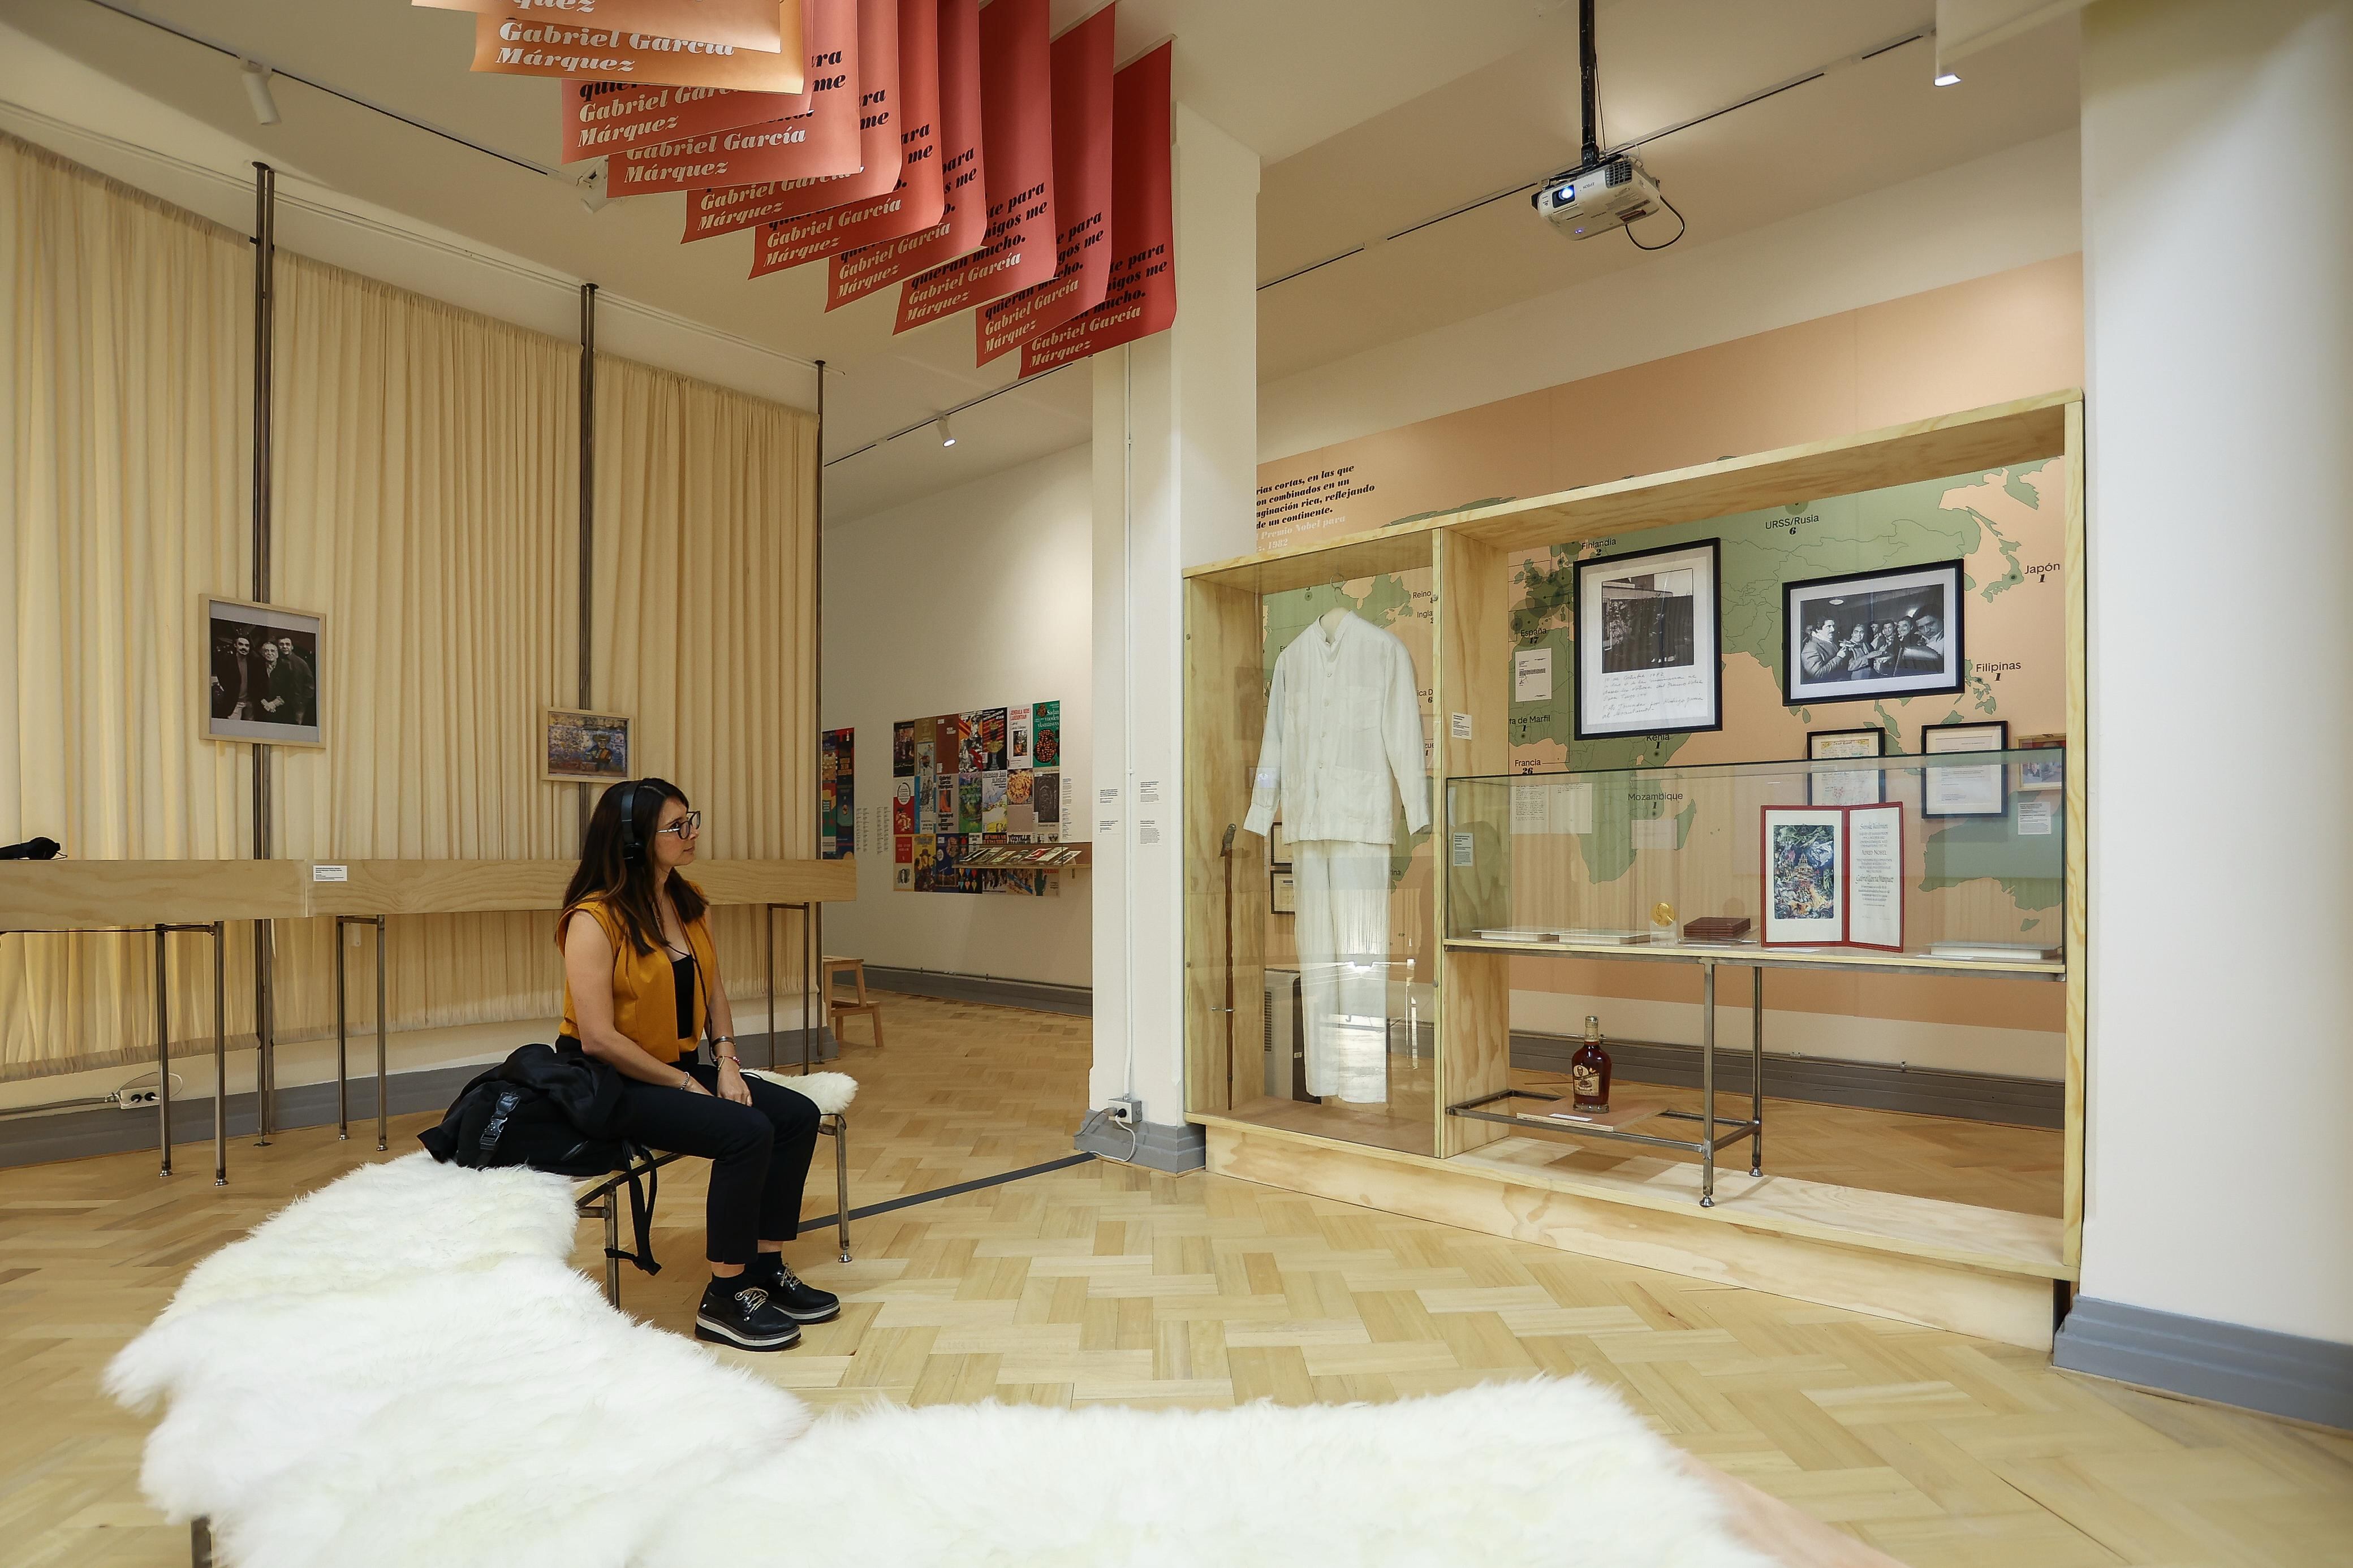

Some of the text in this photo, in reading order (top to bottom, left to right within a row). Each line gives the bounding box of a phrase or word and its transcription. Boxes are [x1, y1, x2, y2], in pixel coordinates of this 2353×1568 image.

[499, 22, 620, 48] Gabriel
[495, 47, 636, 72] Márquez
[813, 74, 846, 92] me
[579, 89, 668, 123] Gabriel
[578, 115, 679, 147] Márquez
[860, 112, 889, 130] me
[626, 126, 806, 161] Gabriel García
[908, 145, 933, 164] me
[624, 160, 729, 184] Márquez
[956, 167, 977, 188] me
[701, 180, 775, 210] Gabriel
[1007, 182, 1045, 213] para
[697, 201, 784, 231] Márquez
[767, 215, 834, 248] Gabriel
[838, 198, 902, 227] García
[1026, 201, 1048, 221] me
[1068, 211, 1102, 242] para
[1084, 229, 1104, 248] me
[763, 236, 841, 267] Márquez
[839, 244, 895, 280] Gabriel
[897, 222, 951, 254] García
[911, 257, 968, 289] quieran
[972, 233, 1026, 262] mucho.
[1127, 243, 1165, 270] para
[836, 264, 900, 300] Márquez
[908, 251, 1022, 305] Gabriel García
[1146, 261, 1167, 278] me
[905, 290, 971, 322] Márquez
[985, 286, 1035, 320] quieran
[985, 278, 1079, 336] Gabriel García
[1094, 289, 1147, 314] mucho.
[984, 319, 1037, 354] Márquez
[1032, 321, 1085, 351] Gabriel
[1089, 304, 1141, 332] García
[1029, 339, 1092, 368] Márquez
[1274, 477, 1305, 491] cortas,
[1307, 474, 1318, 483] en
[1321, 469, 1335, 480] las
[1337, 464, 1355, 477] que
[1269, 485, 1321, 504] combinados
[1323, 482, 1335, 491] en
[1337, 478, 1350, 487] un
[1301, 498, 1322, 508] rica,
[1325, 483, 1376, 502] reflejando
[1261, 515, 1346, 540] Premio Nobel para
[1268, 518, 1280, 527] un
[1282, 506, 1333, 524] continente.
[1765, 513, 1819, 530] URSS/Rusia
[1789, 526, 1796, 535] 6
[1581, 538, 1617, 551] Finlandia
[2024, 562, 2061, 575] Japón
[1413, 590, 1432, 599] Reino
[1417, 610, 1434, 619] Ingla
[1520, 628, 1547, 637] España
[1976, 660, 2022, 672] Filipinas
[1529, 714, 1550, 723] Marfil
[1515, 759, 1541, 767] Francia
[1628, 792, 1683, 802] Mozambique
